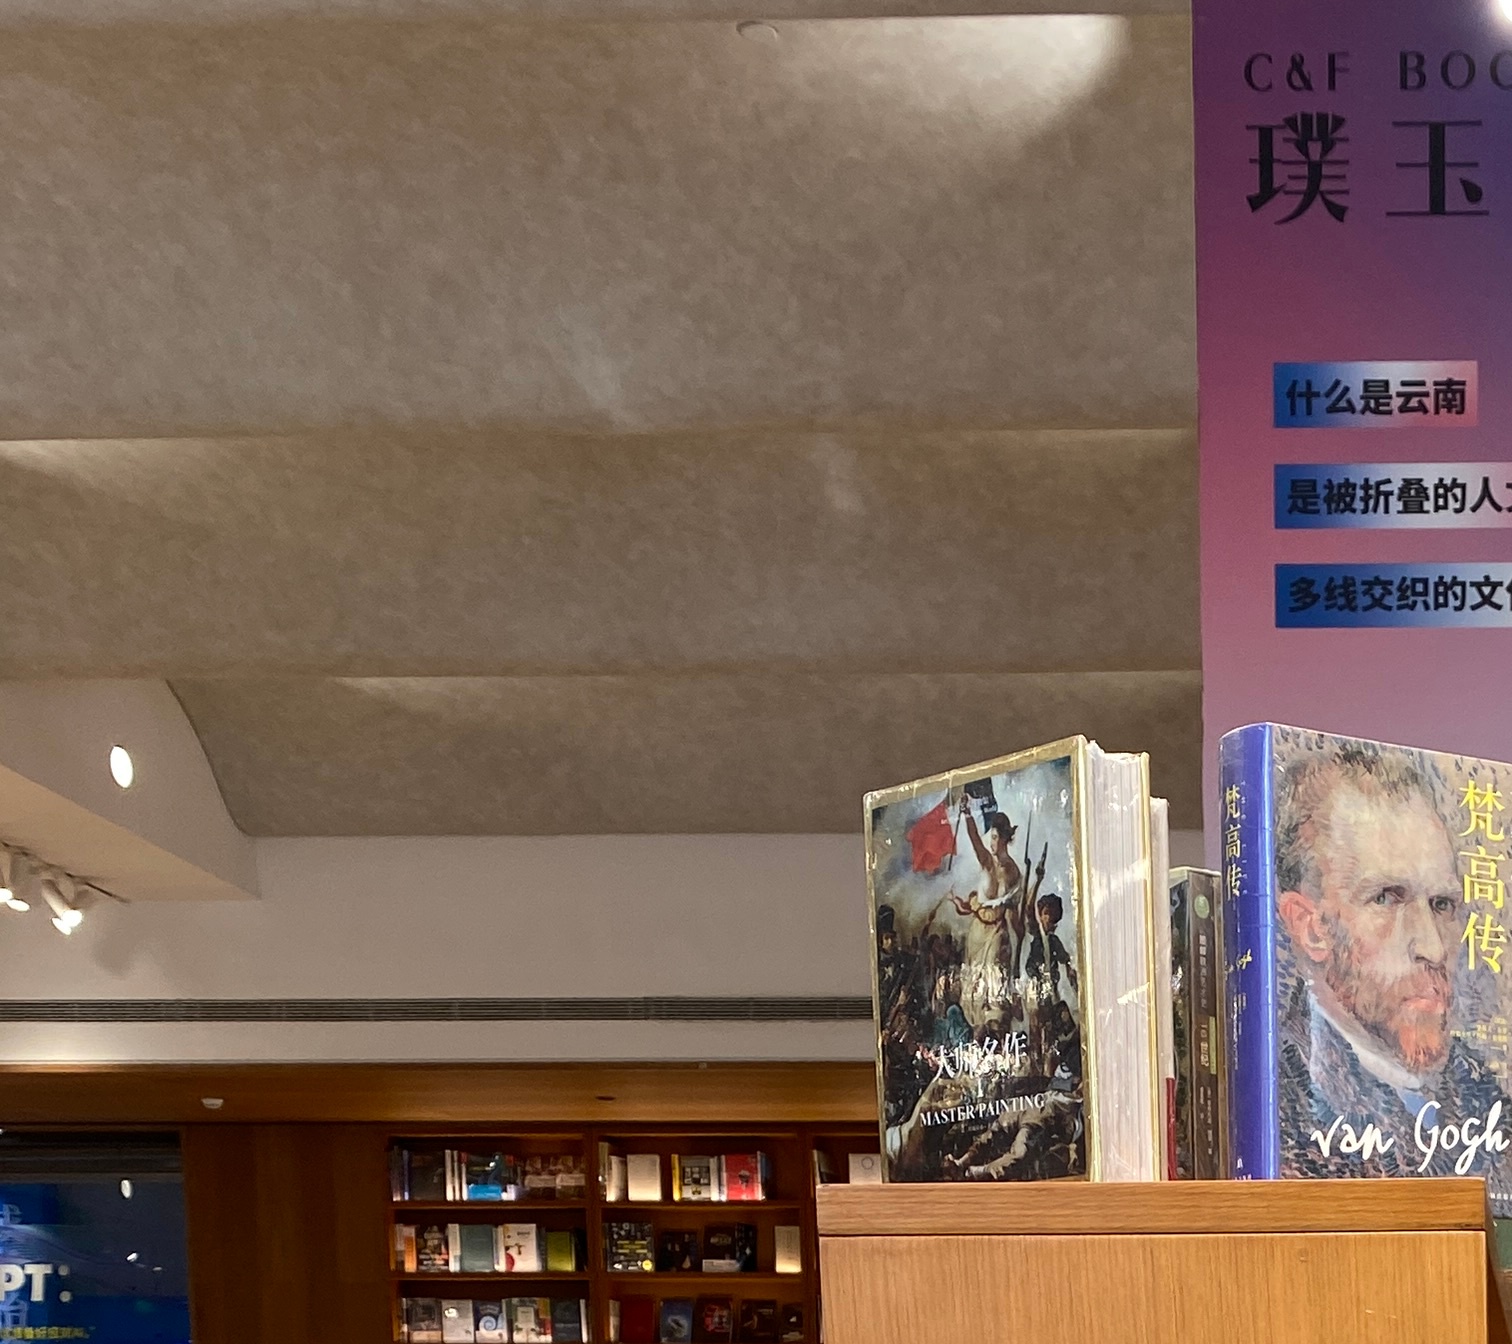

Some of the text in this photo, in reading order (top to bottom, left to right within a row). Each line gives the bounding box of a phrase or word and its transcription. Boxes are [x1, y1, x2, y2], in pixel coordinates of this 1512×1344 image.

[1244, 50, 1351, 92] C&F
[1285, 378, 1467, 417] 什么是云南
[1224, 784, 1243, 898] 梵高传
[1459, 780, 1507, 973] 梵高传
[920, 1092, 1046, 1128] MASTER PAINTING
[1311, 1099, 1511, 1177] van Gogh
